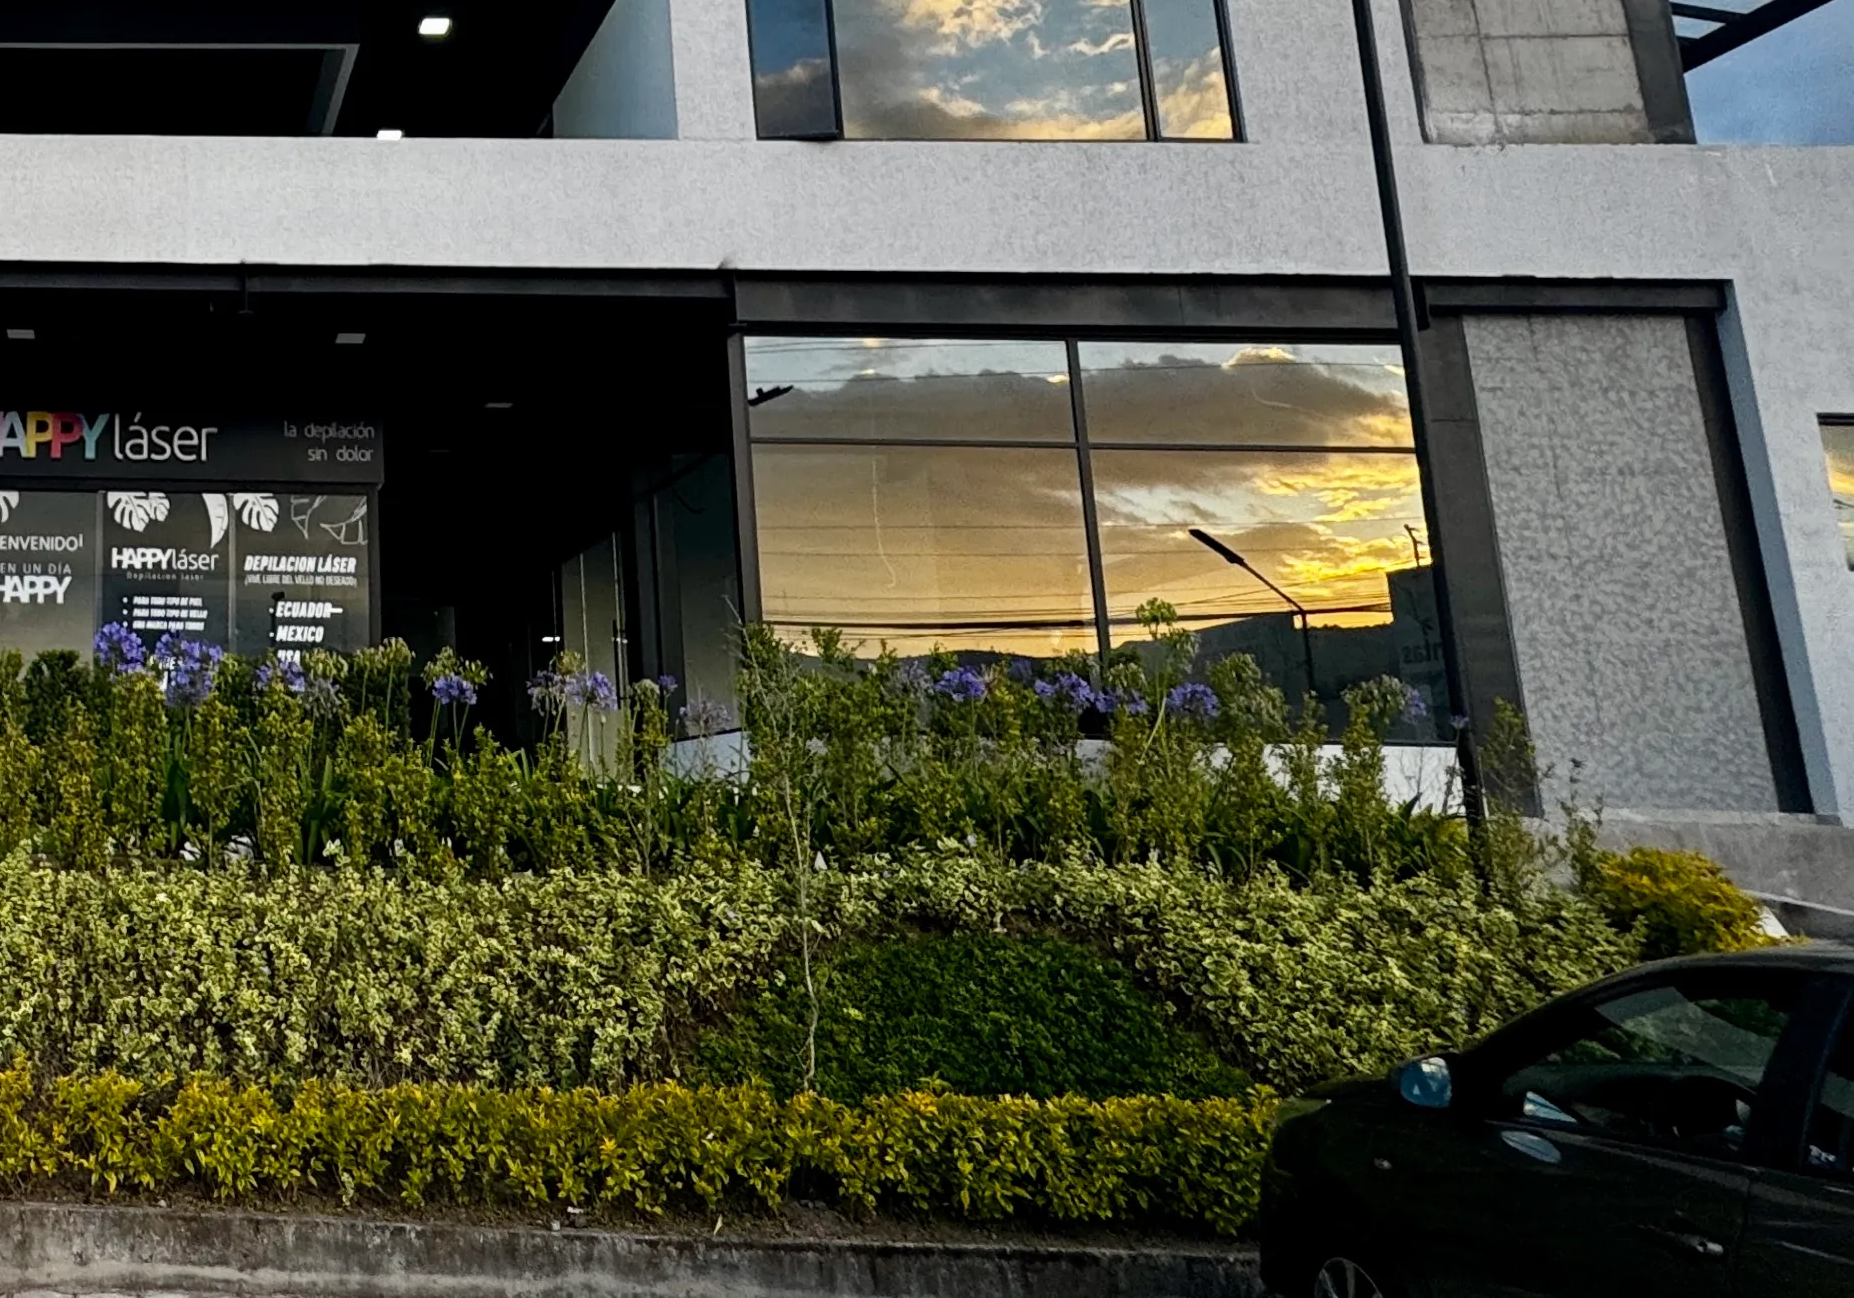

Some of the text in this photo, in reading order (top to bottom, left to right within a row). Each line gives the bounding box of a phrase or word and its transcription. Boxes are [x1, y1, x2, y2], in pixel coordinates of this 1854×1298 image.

[114, 412, 218, 462] láser
[284, 420, 375, 445] la depilación
[307, 444, 374, 462] sin dolor
[22, 563, 42, 574] UN
[48, 561, 72, 575] DÍA
[111, 547, 220, 571] HAPPY láser
[244, 554, 358, 573] DEPILACION LÁSER
[275, 601, 333, 618] ECUADOR
[275, 624, 325, 643] MEXICO
